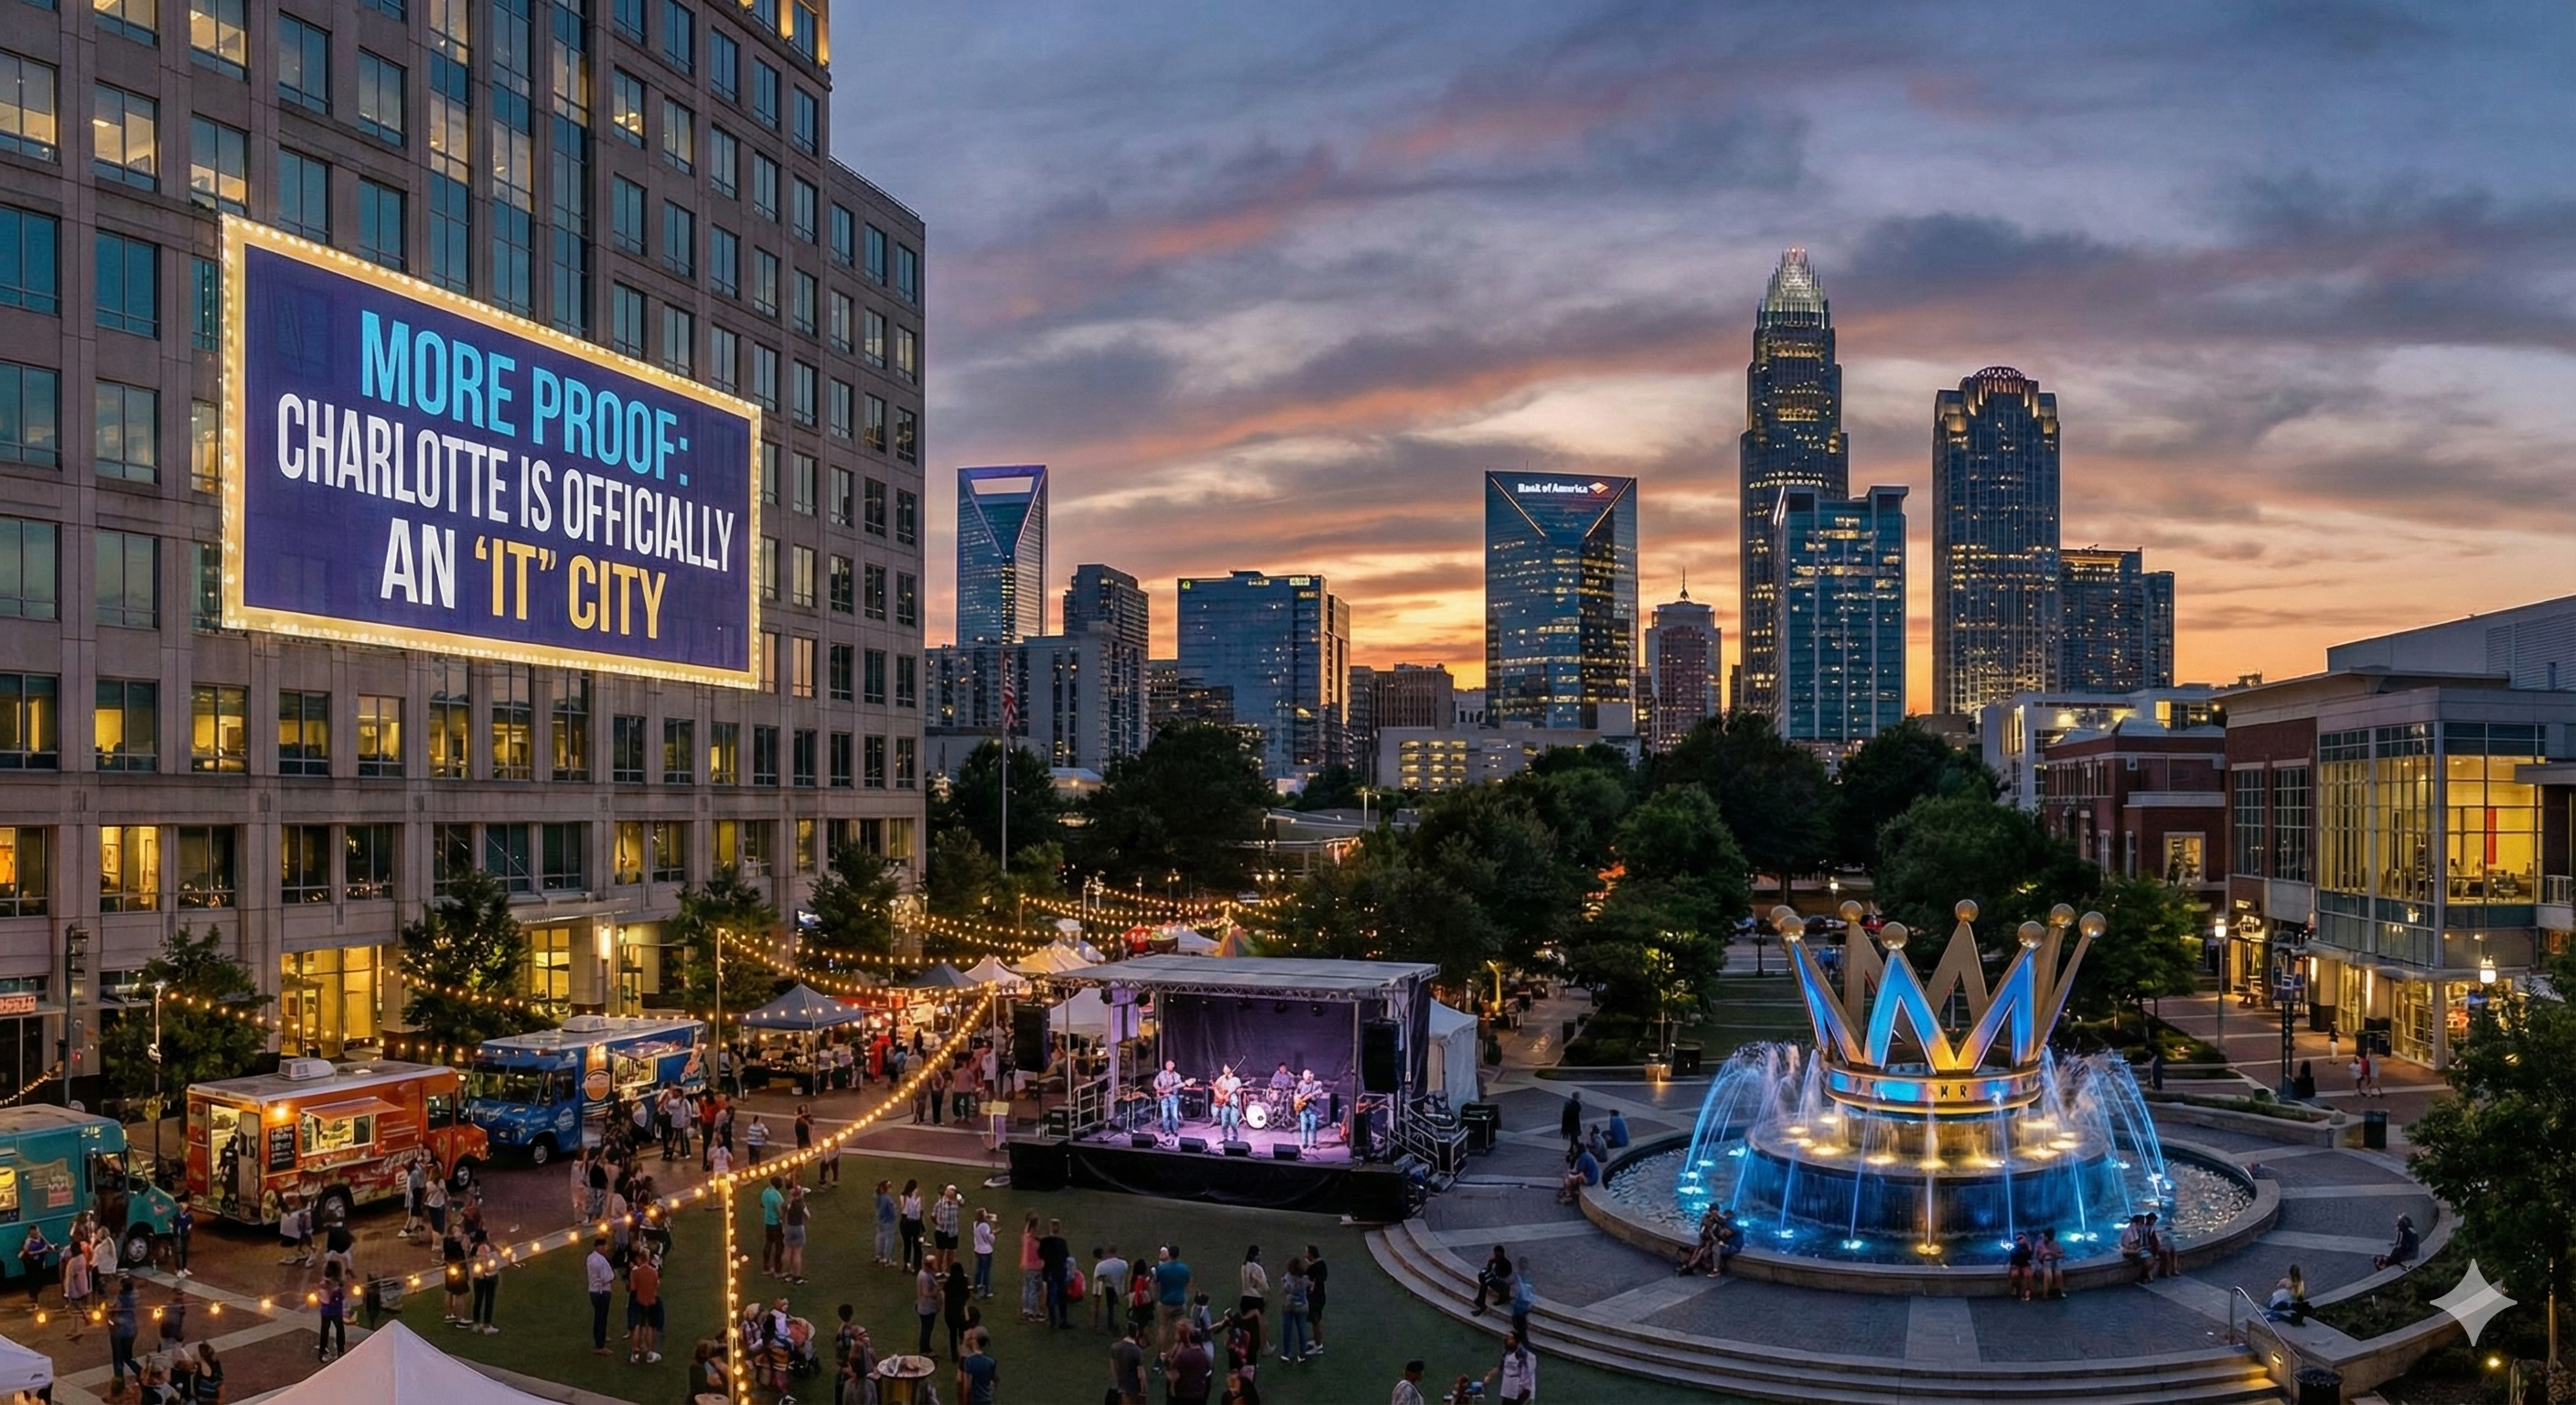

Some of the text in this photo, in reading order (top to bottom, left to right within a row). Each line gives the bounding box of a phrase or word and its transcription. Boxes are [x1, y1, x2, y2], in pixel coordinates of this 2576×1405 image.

[361, 309, 690, 487] MORE PROOF:
[277, 392, 735, 573] CHARLOTTE IS OFFICIALLY
[1518, 483, 1588, 494] Bank of America
[381, 518, 456, 610] AN
[569, 554, 667, 639] CITY
